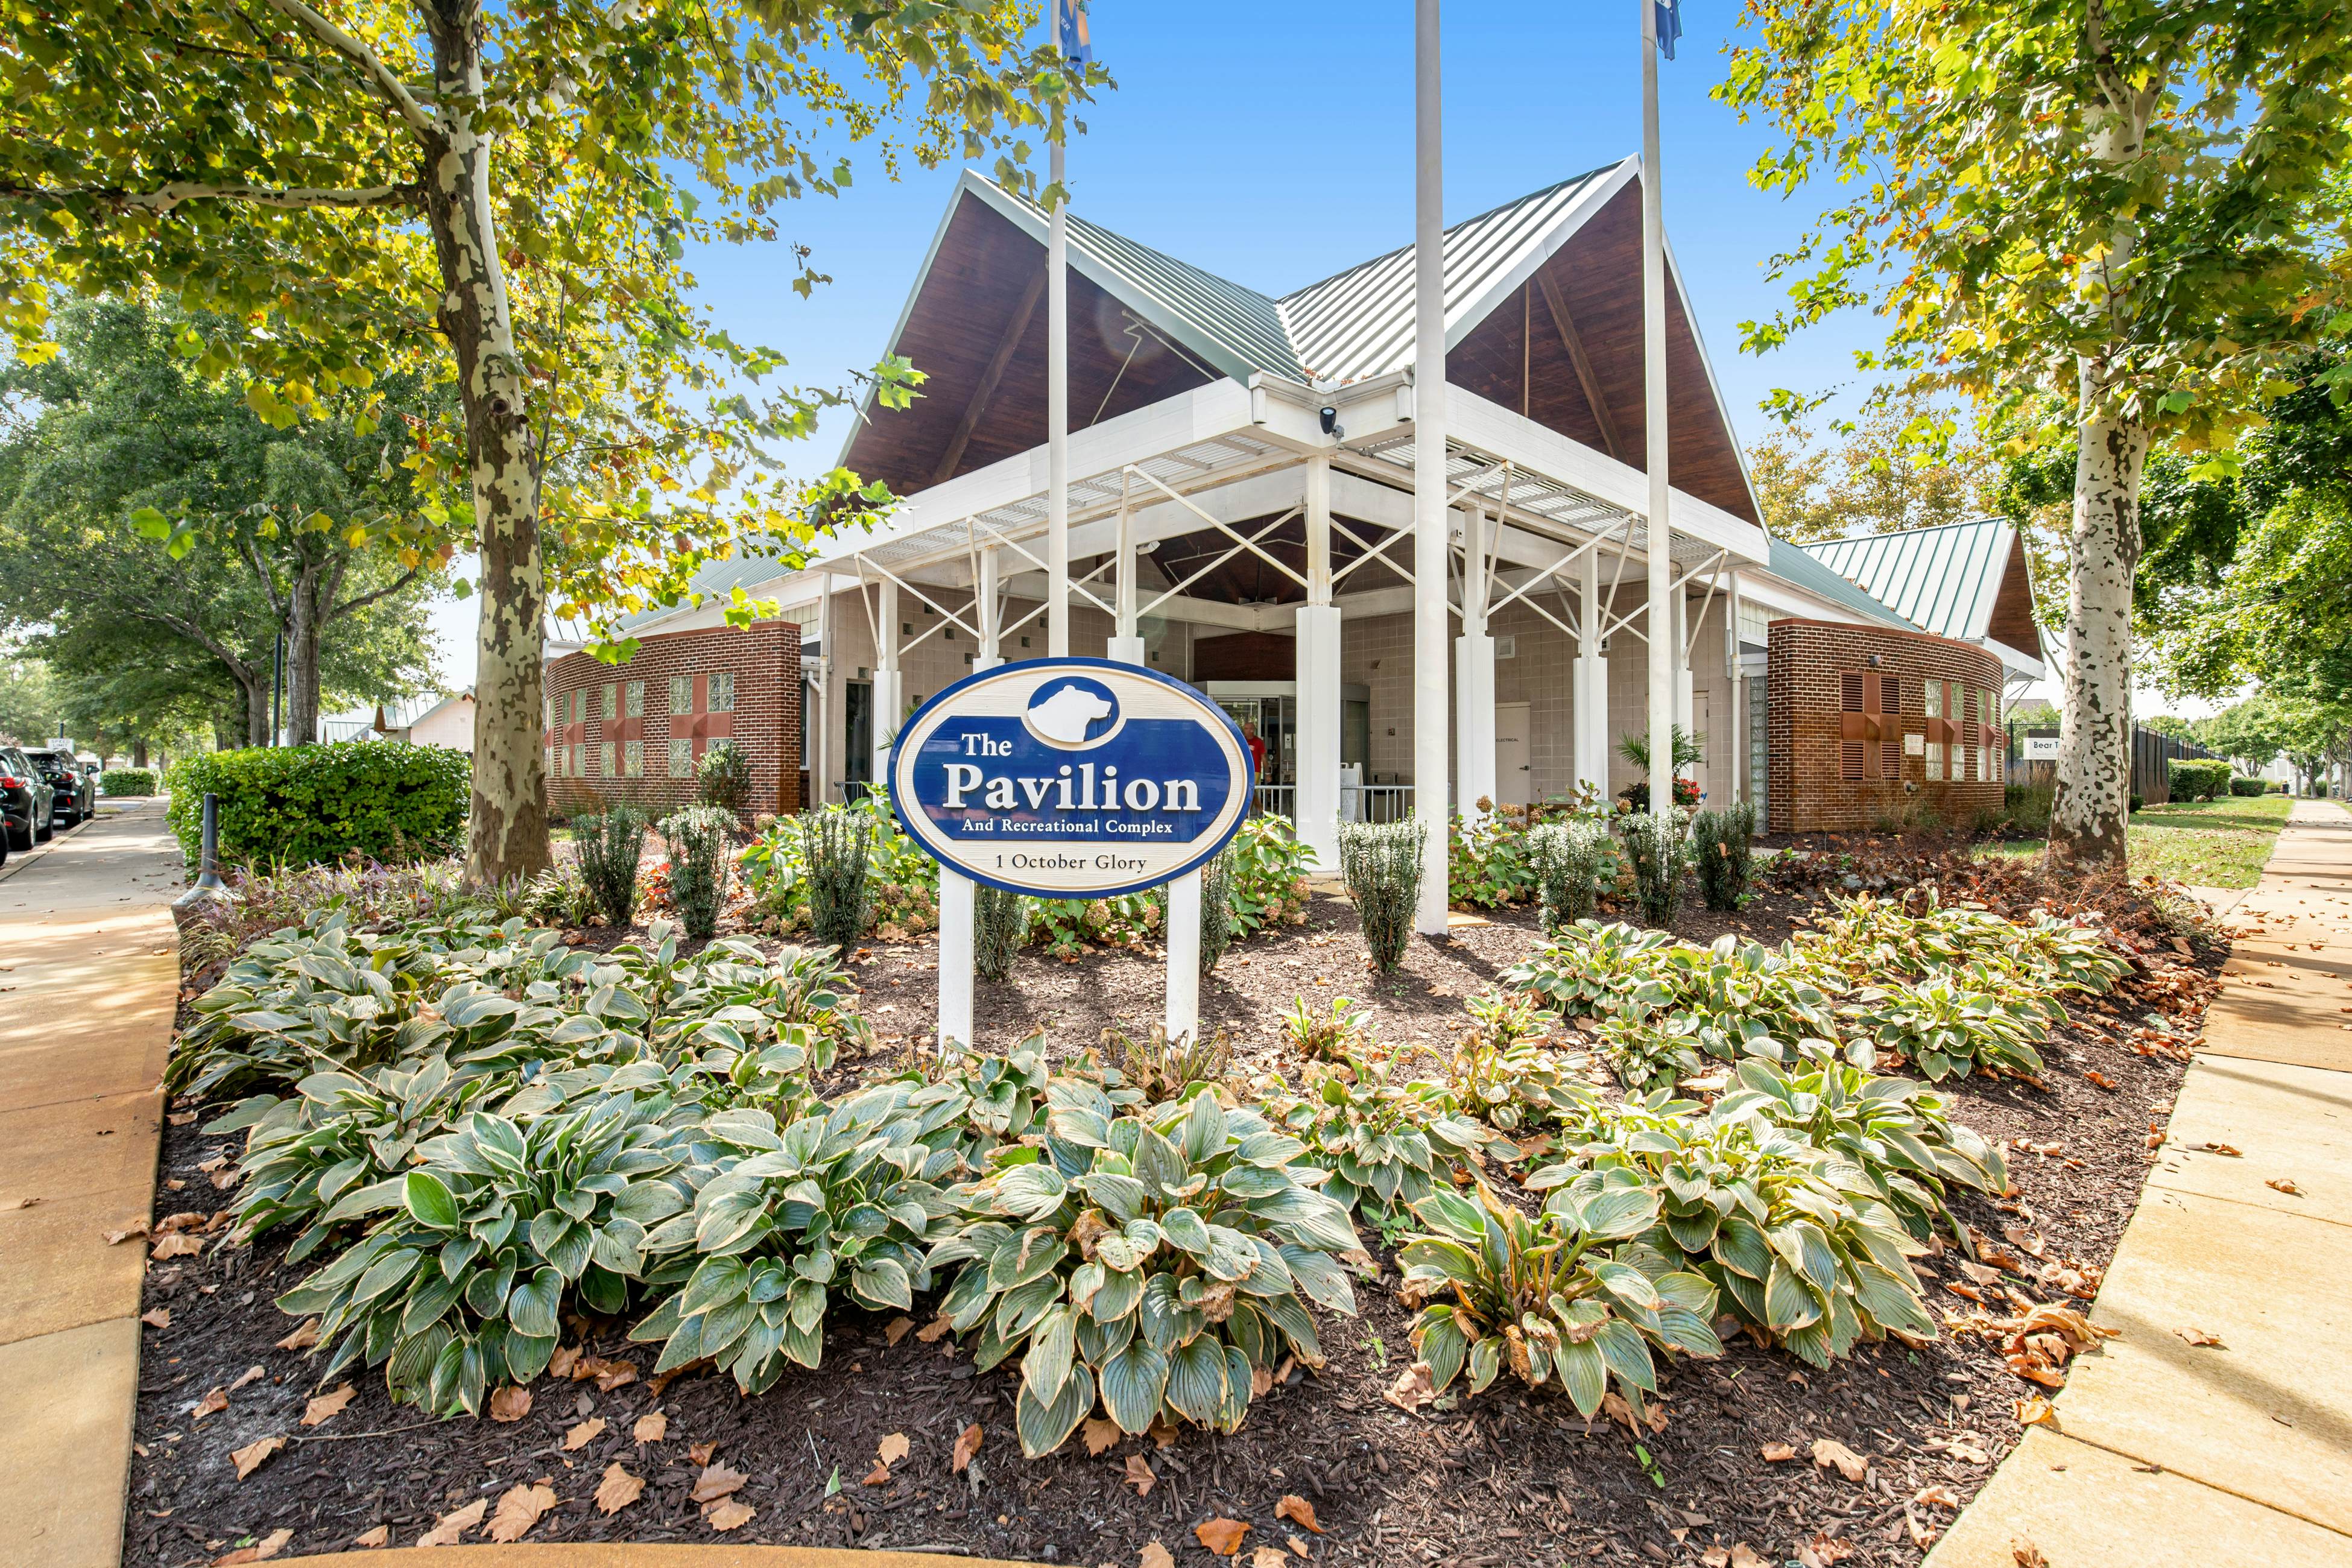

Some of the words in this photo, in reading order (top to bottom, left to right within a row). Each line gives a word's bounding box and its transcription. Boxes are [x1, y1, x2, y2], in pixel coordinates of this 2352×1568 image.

[961, 733, 1012, 756] The
[942, 763, 1201, 811] Pavilion
[962, 818, 994, 832] And
[1002, 818, 1098, 833] Recreational
[1105, 820, 1173, 837] Complex
[996, 854, 1004, 868] 1
[1012, 853, 1086, 869] October
[1095, 854, 1147, 873] Glory
